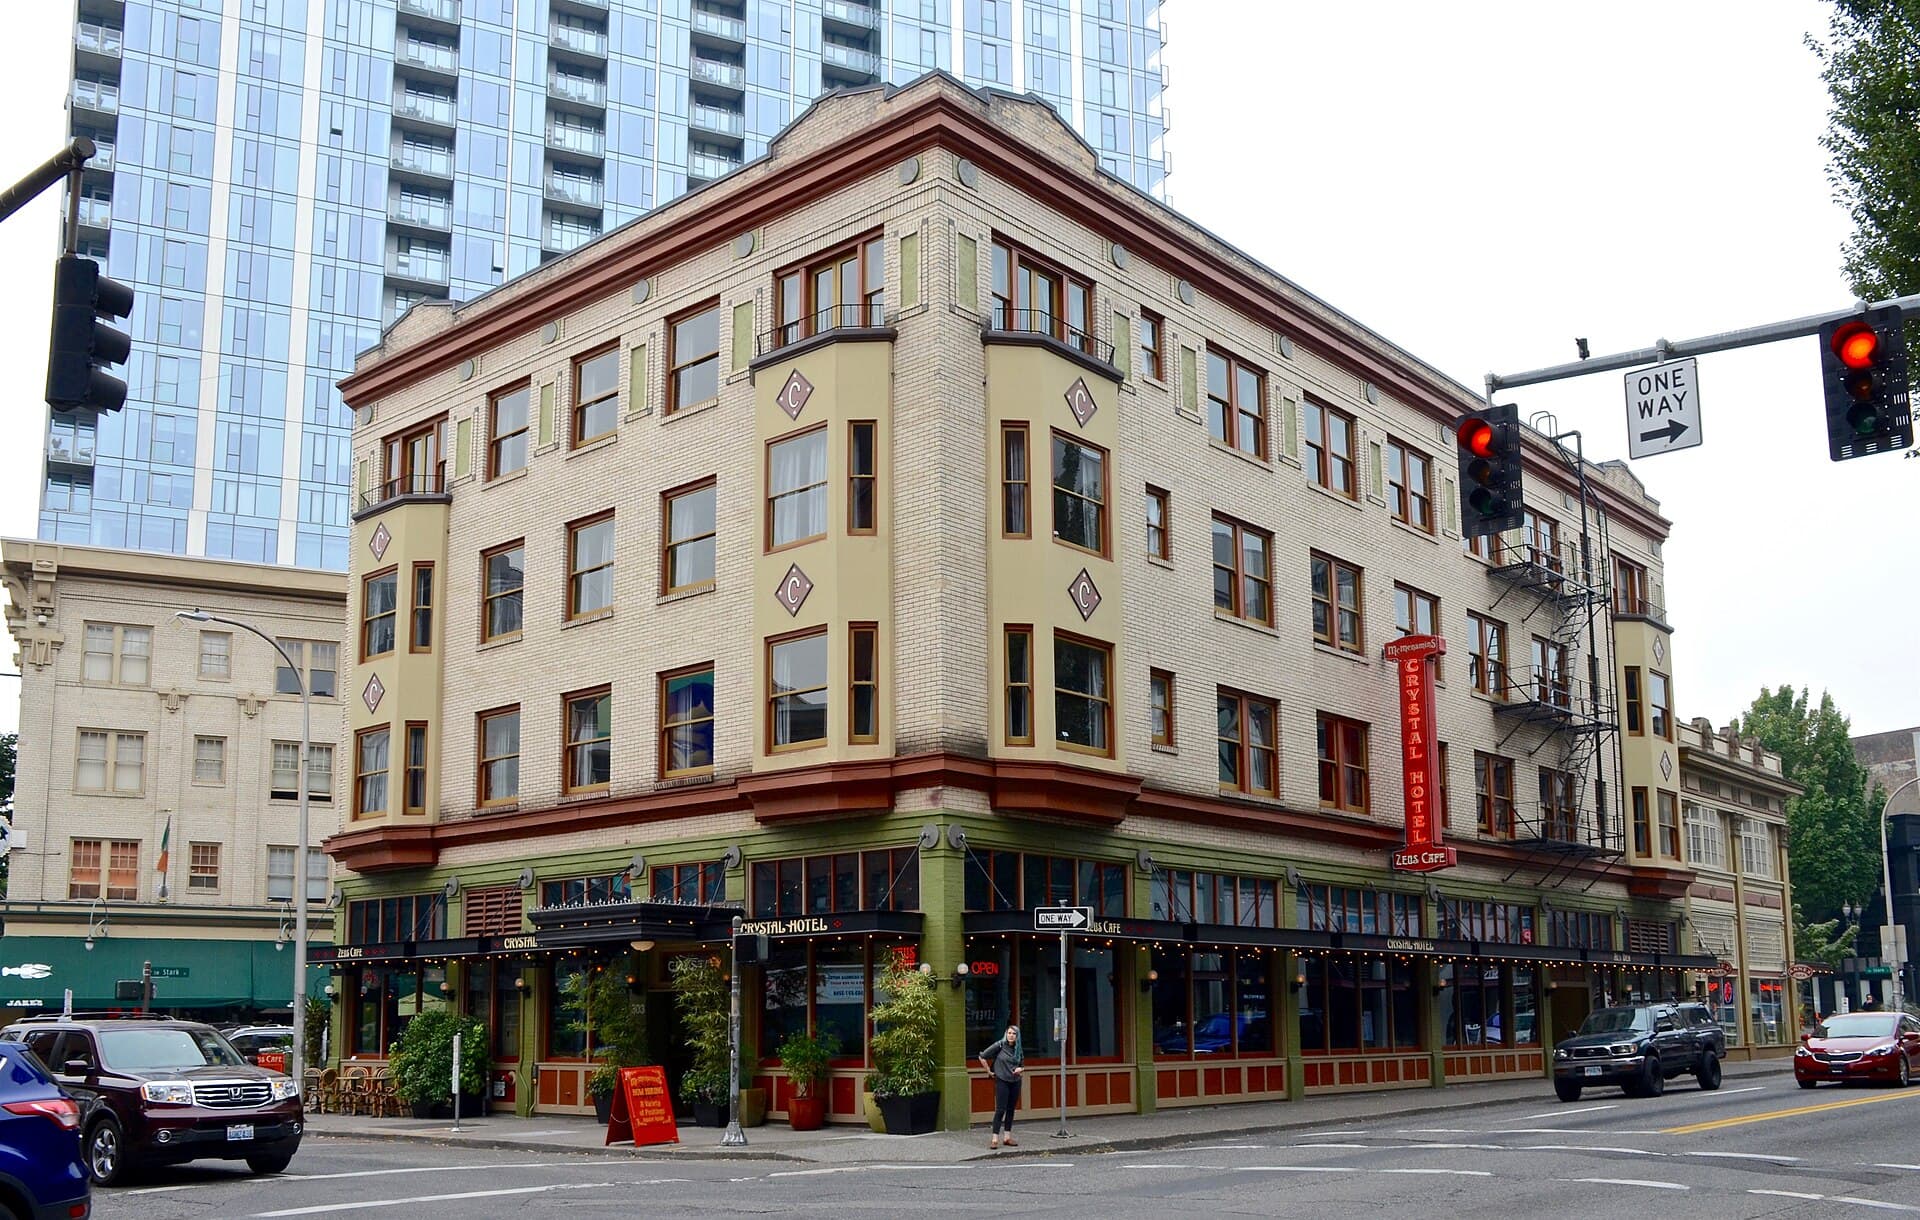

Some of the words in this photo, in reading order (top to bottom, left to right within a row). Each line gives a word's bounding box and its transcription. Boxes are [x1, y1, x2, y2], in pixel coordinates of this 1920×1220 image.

[1638, 368, 1685, 396] ONE
[788, 382, 801, 408] C
[1075, 389, 1087, 415] C
[1638, 391, 1687, 419] WAY
[375, 532, 384, 552] C
[787, 577, 800, 604] C
[1079, 581, 1090, 608] C
[369, 683, 378, 704] C
[1404, 658, 1423, 759] CRYSTAL
[1409, 771, 1427, 843] HOTEL
[740, 921, 786, 935] CRYSTAL
[785, 917, 829, 933] HOTEL
[1040, 914, 1055, 923] ONE
[1057, 914, 1073, 923] WAY
[503, 935, 538, 949] CRYSTAL
[1386, 938, 1413, 950] CRYSTAL
[1412, 940, 1435, 951] HOTEL
[162, 968, 179, 976] Stark
[971, 961, 999, 975] OPEN
